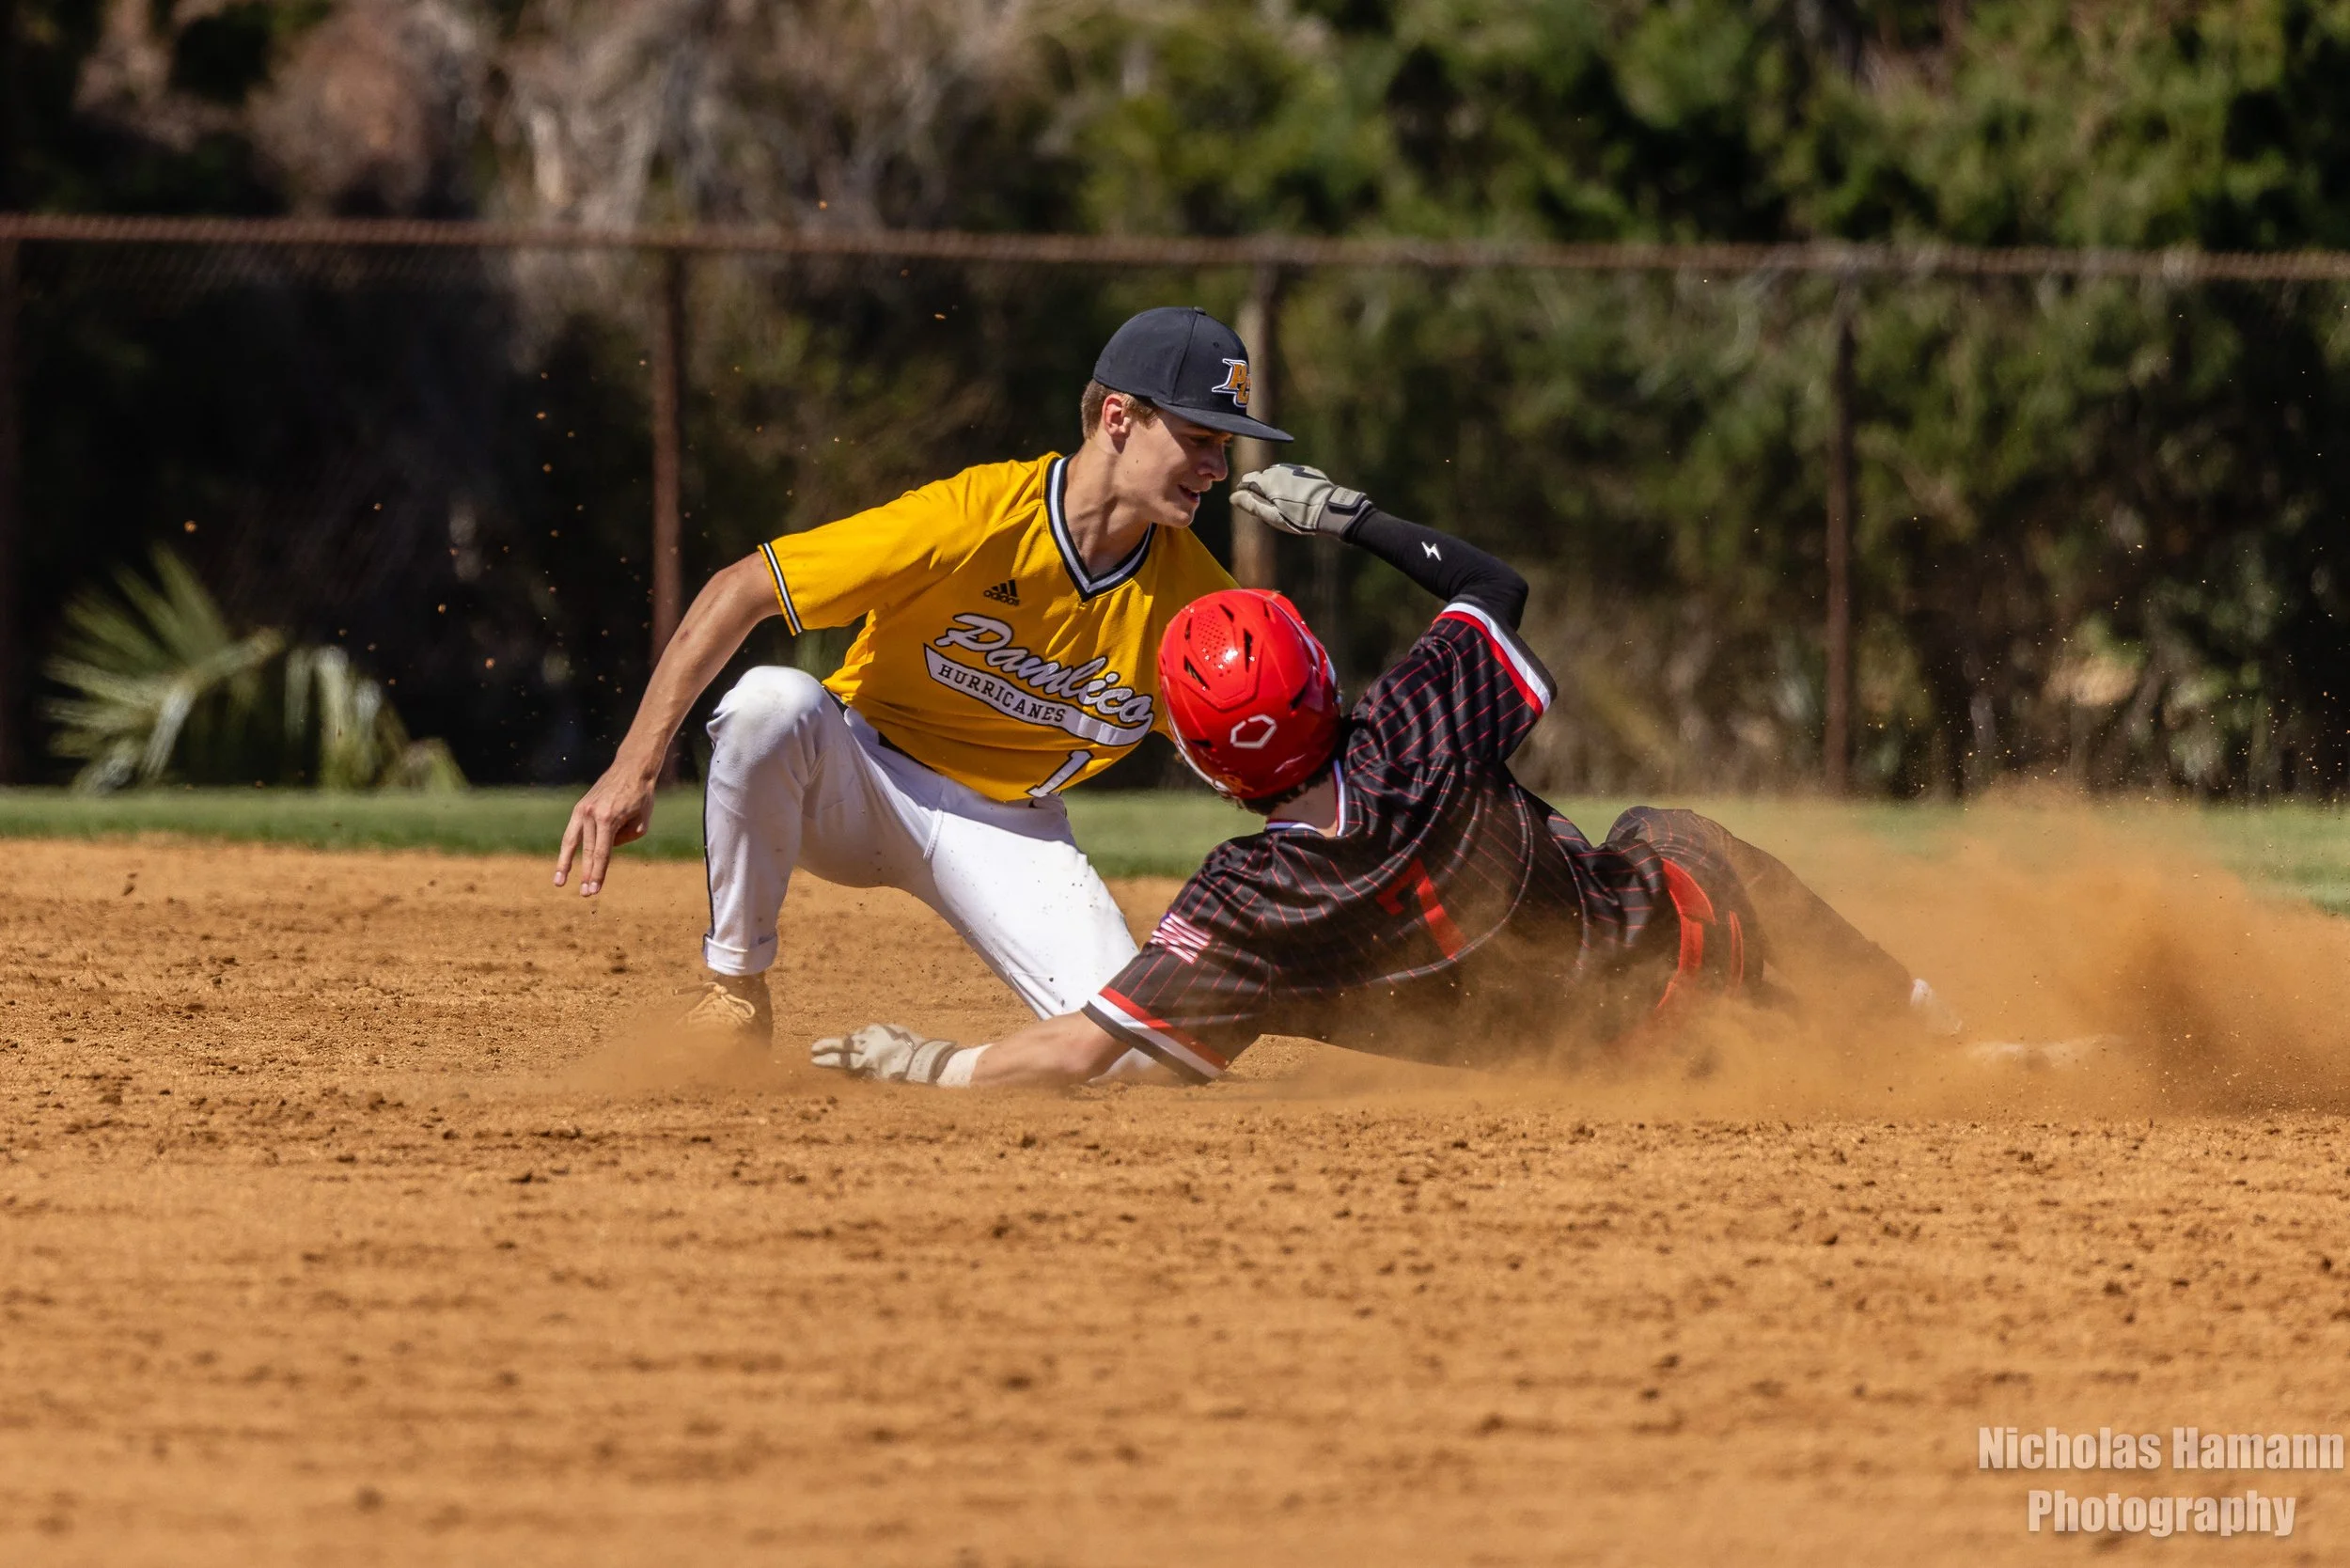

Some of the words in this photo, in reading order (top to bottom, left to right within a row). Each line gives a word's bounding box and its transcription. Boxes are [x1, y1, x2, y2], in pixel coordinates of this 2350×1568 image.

[983, 589, 1021, 606] adidas
[933, 613, 1153, 725] Pamlico
[938, 663, 1066, 723] HURRICANES
